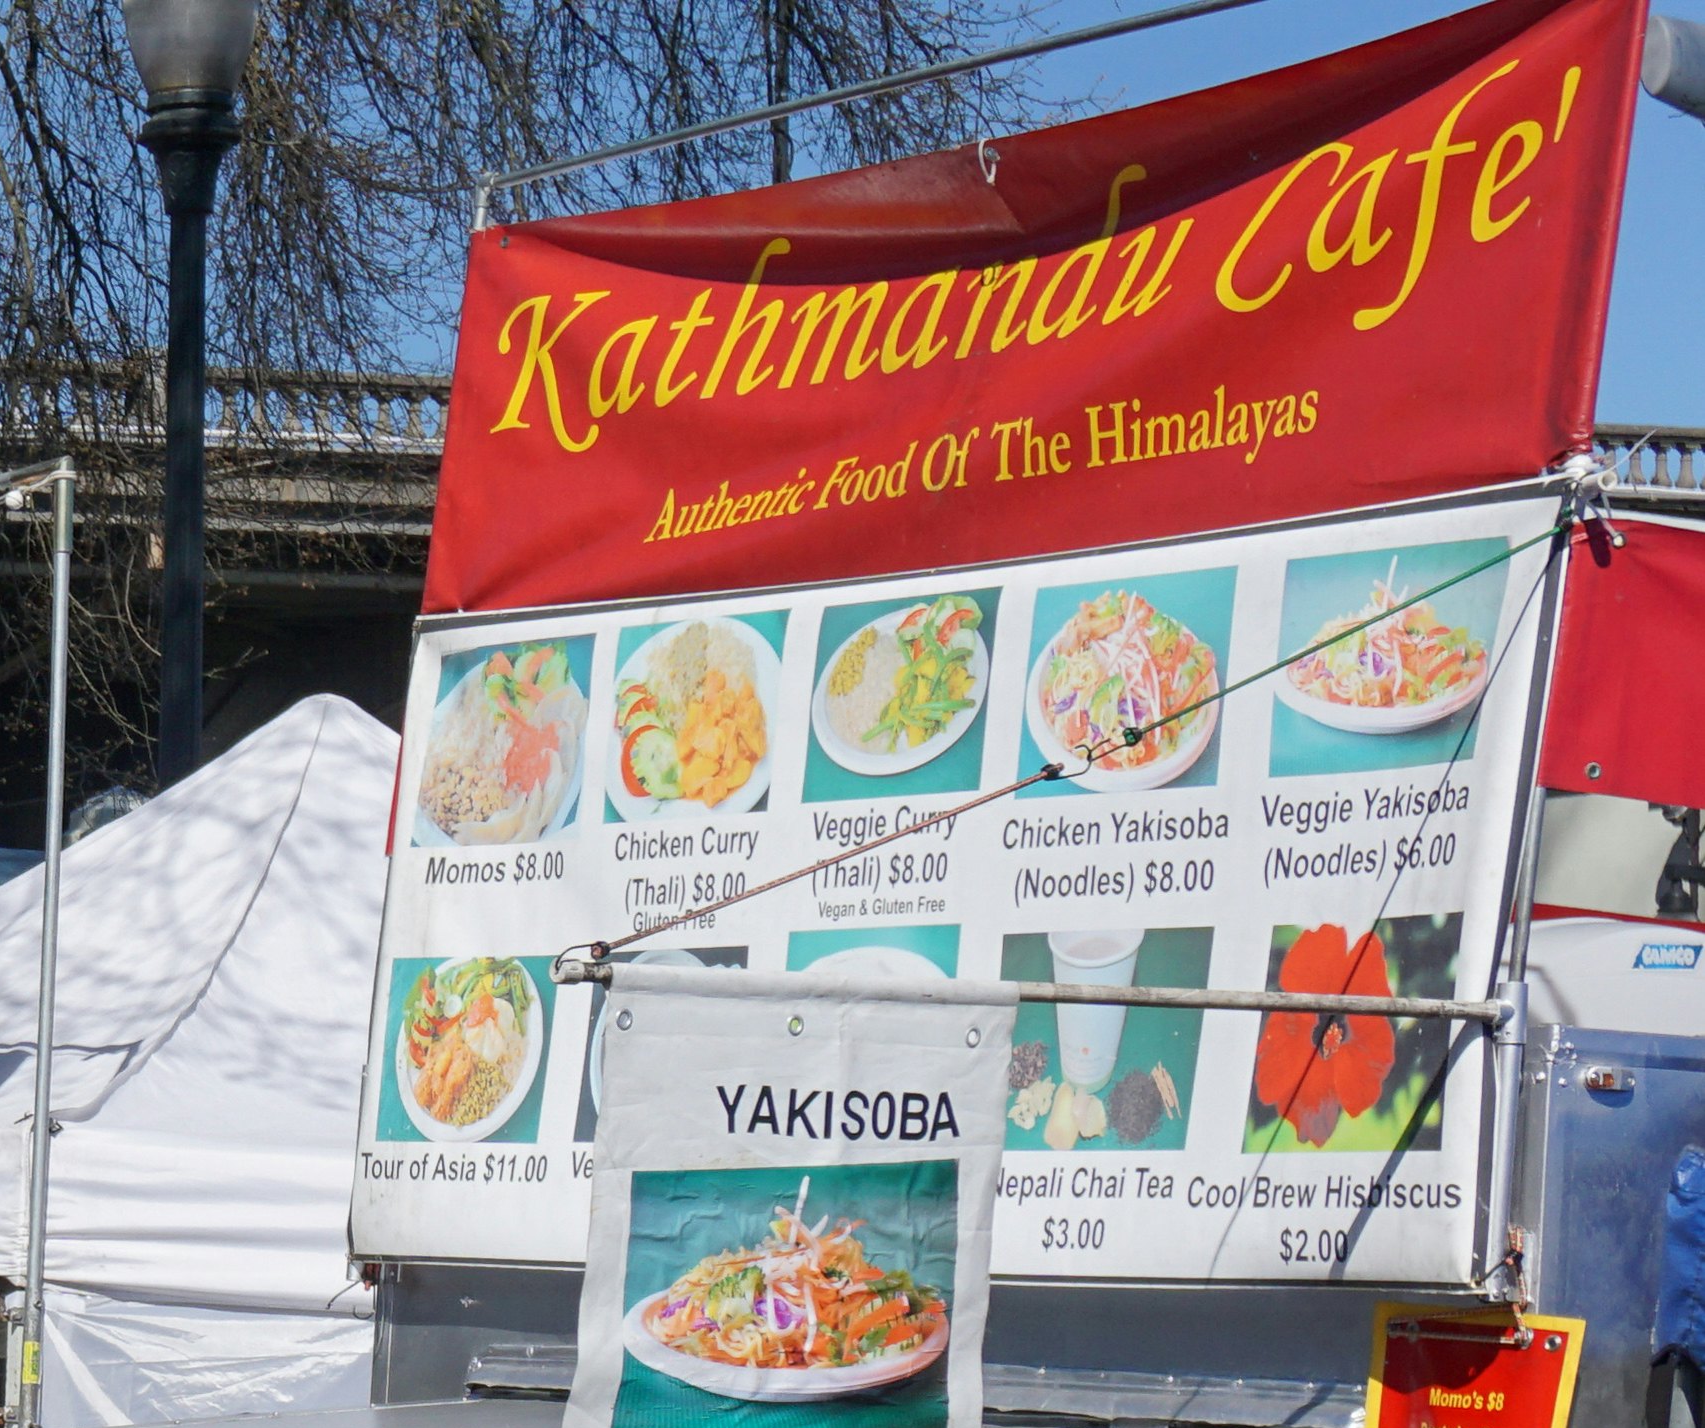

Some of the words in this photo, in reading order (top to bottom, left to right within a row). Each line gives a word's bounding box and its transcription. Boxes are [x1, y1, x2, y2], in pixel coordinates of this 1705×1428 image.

[490, 162, 1194, 453] Kathmandu
[644, 467, 816, 545] Authentic
[813, 439, 909, 512] Food
[921, 431, 983, 493] Of
[991, 417, 1073, 482] The
[1085, 384, 1321, 480] Himalayas
[812, 809, 887, 845] Veggie
[894, 804, 958, 842] Curry
[1261, 792, 1355, 830] Veggie
[1361, 784, 1470, 820] Yakisoba
[614, 830, 692, 861] Chicken
[698, 825, 760, 862] Curry
[1002, 815, 1102, 852] Chicken
[1110, 807, 1230, 844] Yakisoba
[425, 861, 506, 886] Momos
[513, 849, 565, 884] $8.00
[811, 856, 882, 895] (Thali)
[888, 852, 949, 887] $8.00
[1263, 846, 1388, 889] (Noodles)
[1393, 832, 1456, 872] $6.00
[624, 876, 687, 913] (Thali)
[693, 871, 746, 906] $8.00
[1013, 864, 1135, 908] (Noodles)
[1143, 858, 1215, 896] $8.00
[633, 910, 678, 934] Gluten
[818, 900, 854, 921] Vegan
[859, 899, 869, 917] &
[872, 898, 912, 917] Gluten
[917, 896, 946, 914] Free
[717, 1084, 961, 1141] YAKISOBA
[361, 1152, 404, 1182] Tour
[409, 1151, 428, 1182] of
[432, 1152, 477, 1182] Asia
[483, 1152, 548, 1185] $11.00
[1071, 1165, 1127, 1202] Chai
[1133, 1164, 1176, 1199] Tea
[1186, 1174, 1245, 1209] Cool
[1252, 1174, 1316, 1210] Brew
[1324, 1173, 1462, 1210] Hisbiscus
[1042, 1216, 1105, 1252] $3.00
[1279, 1227, 1348, 1263] $2.00
[1429, 1388, 1483, 1411] Momo's
[1486, 1391, 1505, 1412] $8
